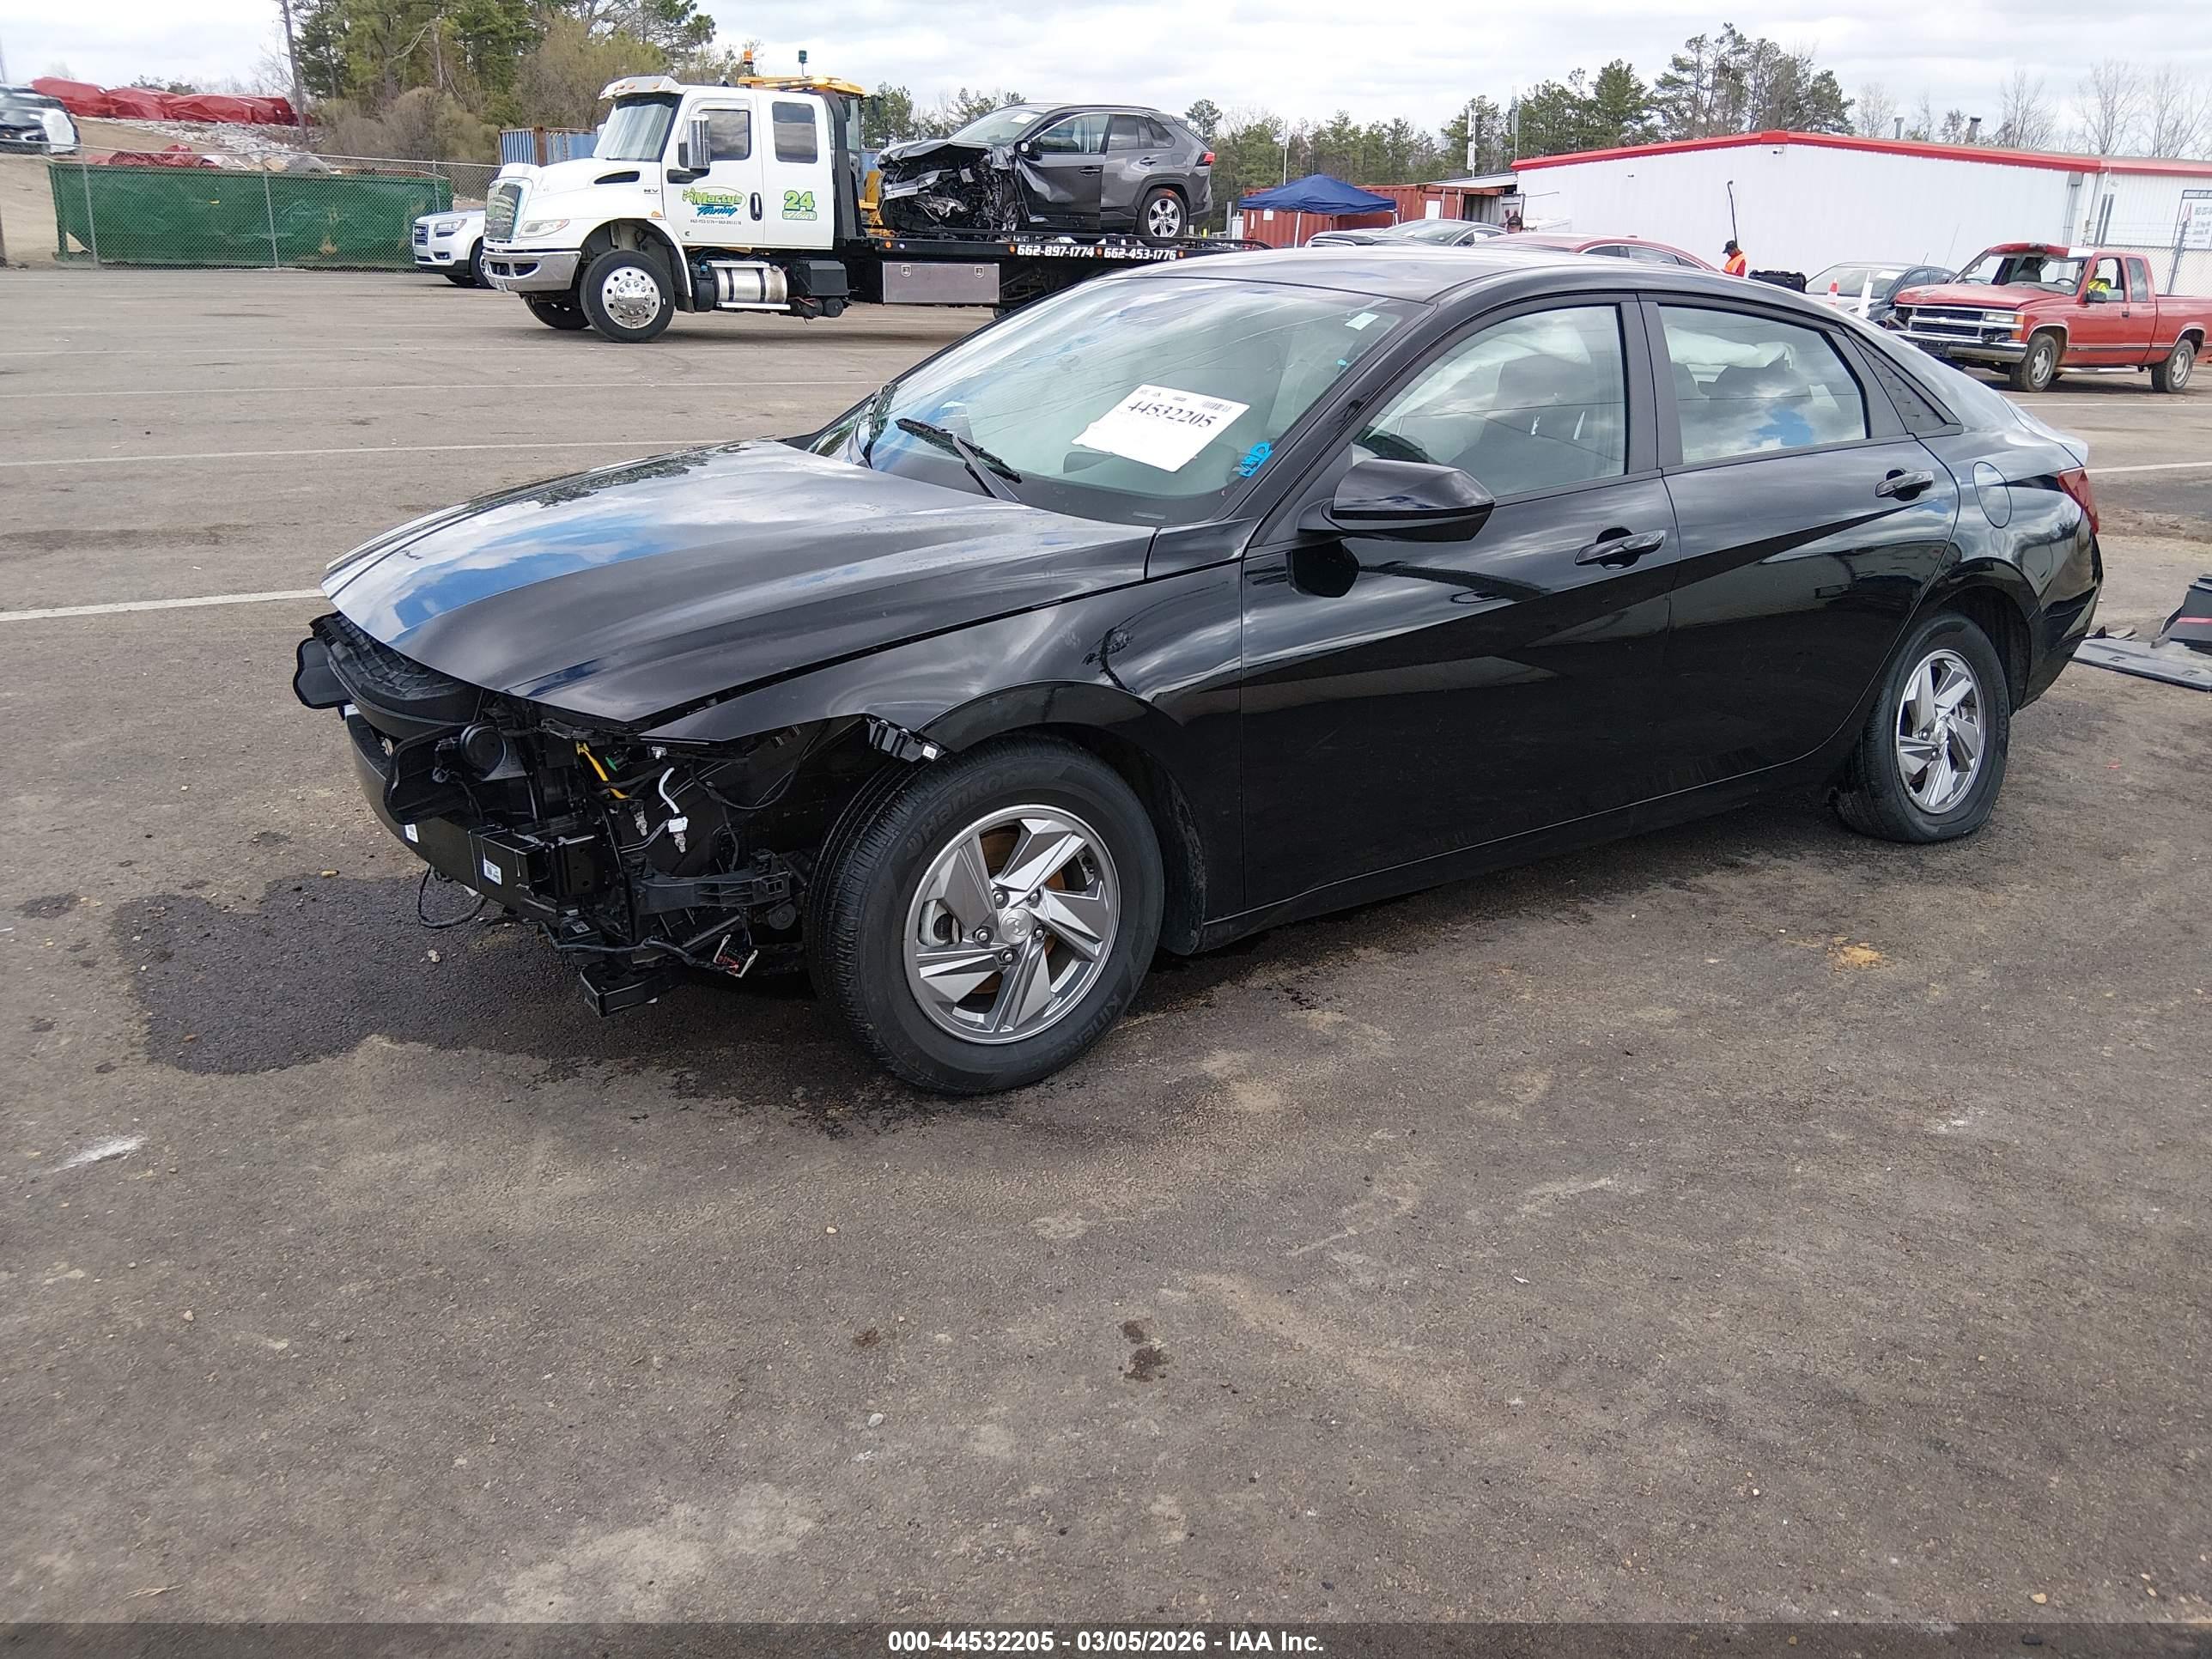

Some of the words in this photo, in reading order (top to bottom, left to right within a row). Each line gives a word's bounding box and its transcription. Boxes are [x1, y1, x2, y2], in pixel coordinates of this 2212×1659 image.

[783, 190, 817, 211] 24
[696, 204, 738, 216] Towing
[1017, 245, 1095, 258] 662-897-1774
[1104, 247, 1177, 261] 662-453-1776
[1127, 400, 1218, 428] 44532205
